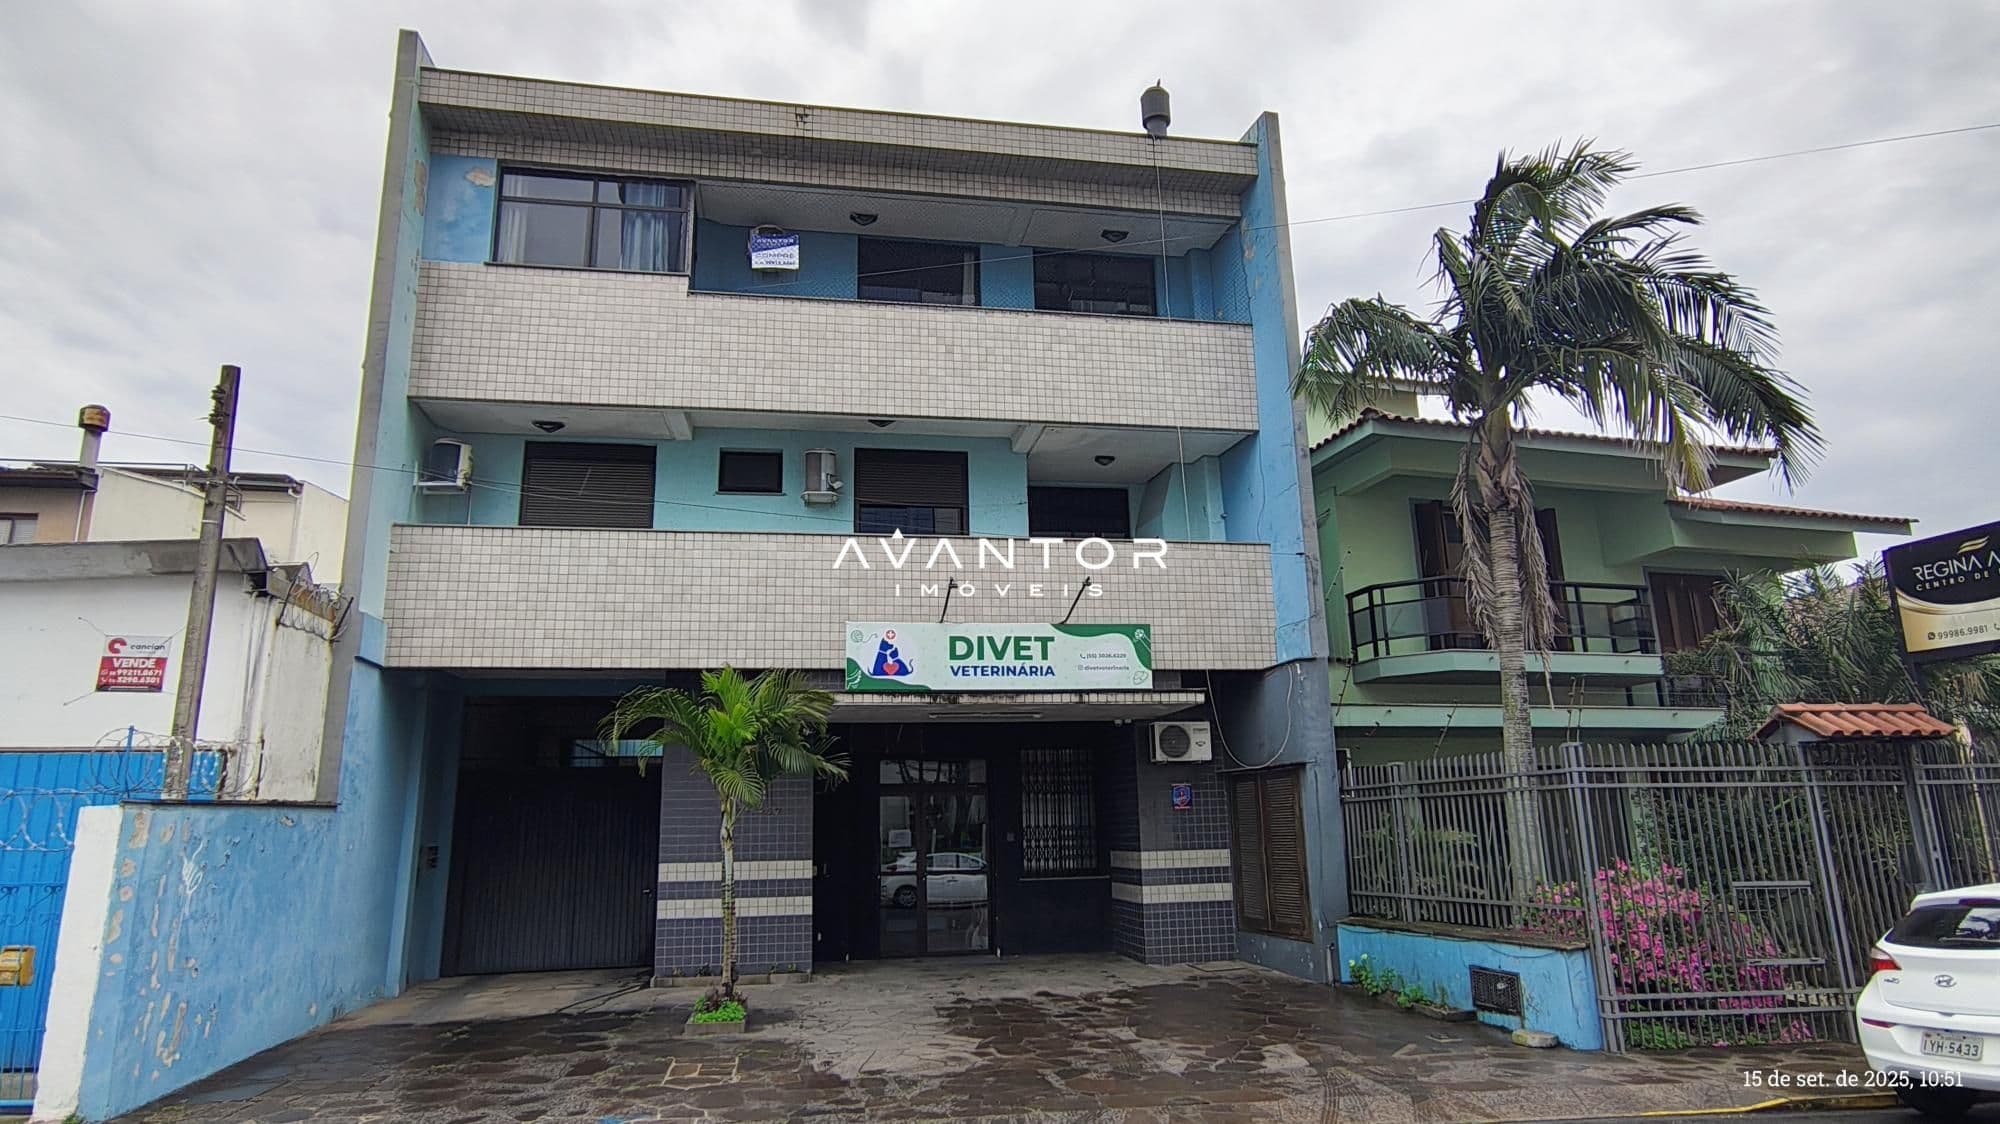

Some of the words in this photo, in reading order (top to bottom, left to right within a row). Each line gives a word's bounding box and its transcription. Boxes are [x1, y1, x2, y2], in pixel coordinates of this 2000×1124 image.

[1912, 555, 1982, 580] REGINA
[1916, 576, 1965, 591] CENTRO
[1974, 571, 1989, 580] DE
[949, 636, 1055, 660] DIVET
[112, 658, 157, 668] VENDE
[950, 662, 1055, 677] VETERINÁRIA
